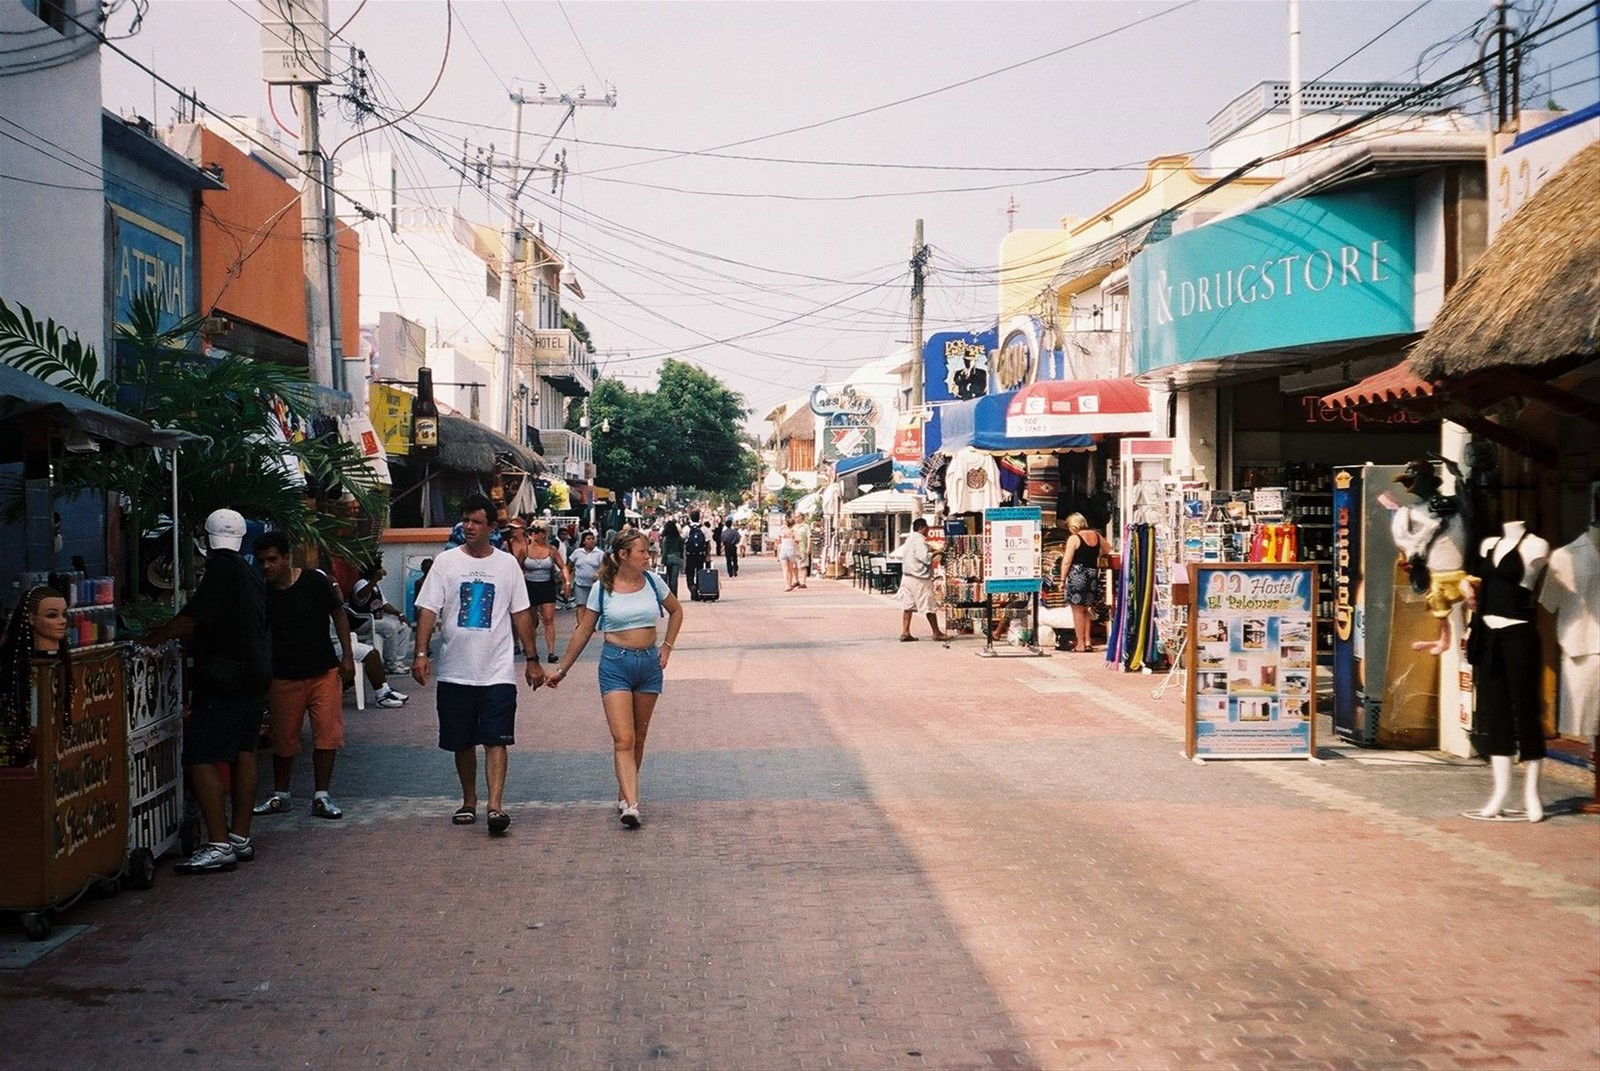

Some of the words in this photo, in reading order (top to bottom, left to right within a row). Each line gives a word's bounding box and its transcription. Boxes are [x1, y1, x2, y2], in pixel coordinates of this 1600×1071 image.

[1180, 240, 1390, 317] DRUGSTORE
[535, 336, 564, 349] HOTEL
[1335, 507, 1353, 641] Corona
[1251, 575, 1299, 594] Hostel
[1208, 596, 1222, 609] El
[1226, 595, 1280, 610] Palomar
